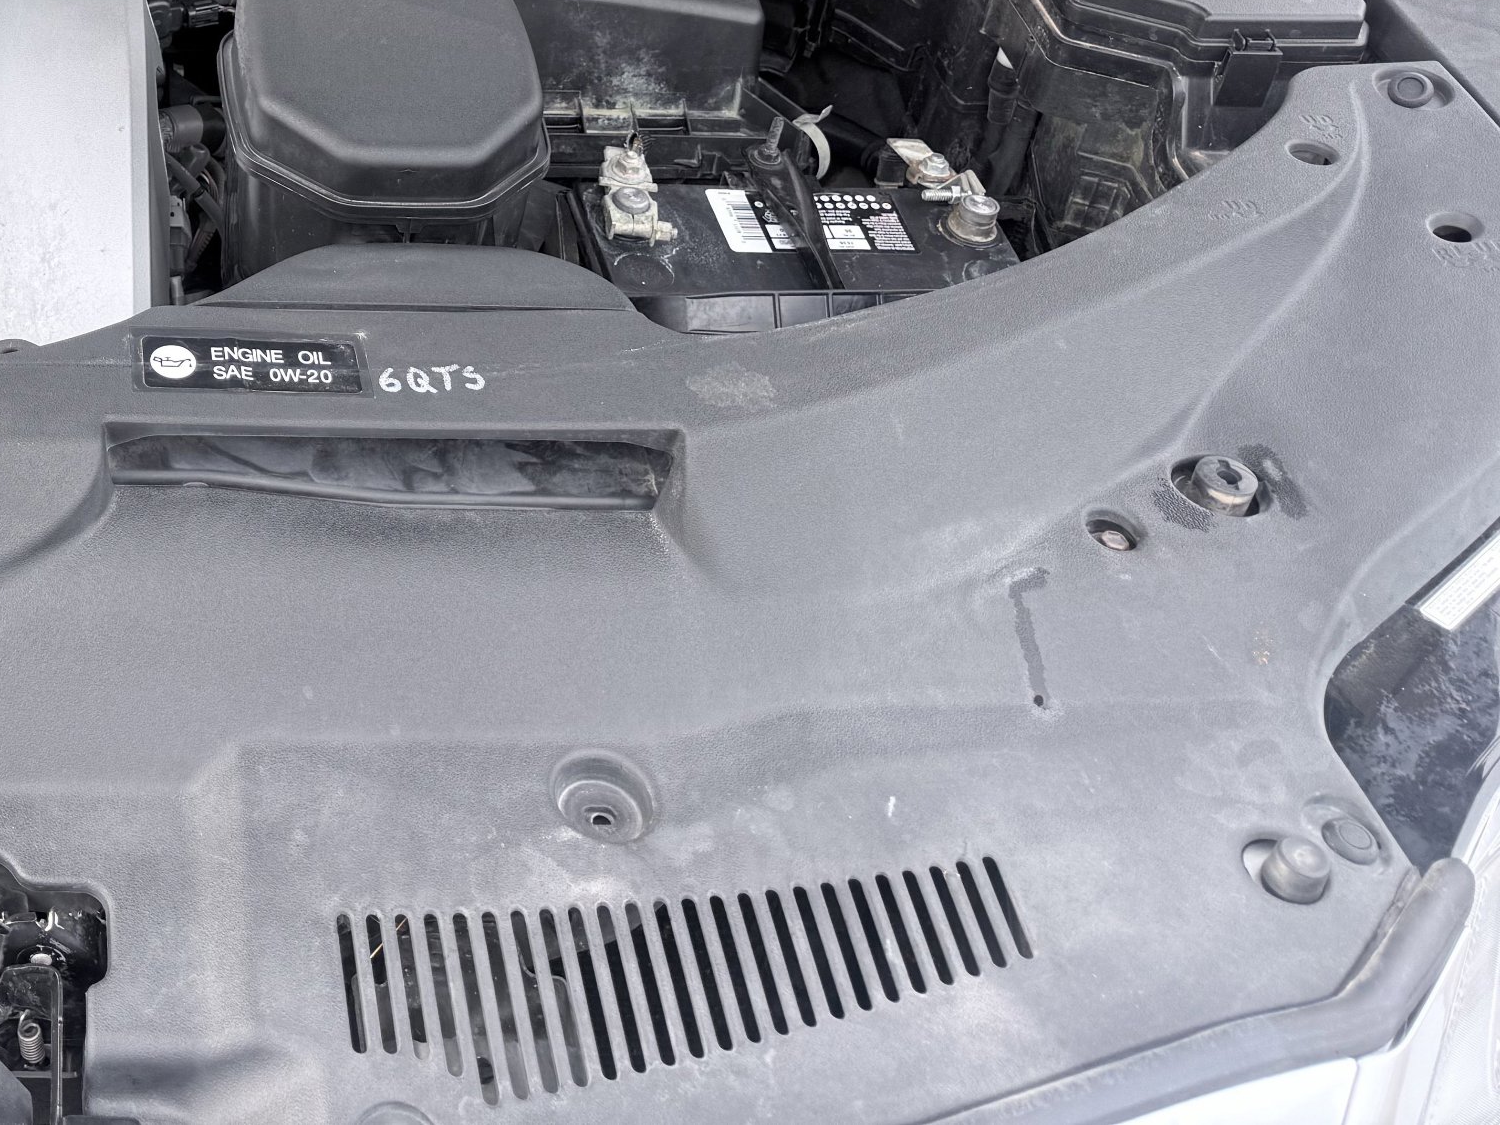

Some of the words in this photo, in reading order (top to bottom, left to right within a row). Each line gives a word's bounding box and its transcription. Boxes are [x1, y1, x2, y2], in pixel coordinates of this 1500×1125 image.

[210, 346, 284, 364] ENGINE
[298, 350, 332, 366] OIL
[212, 365, 254, 381] SAE
[268, 368, 333, 384] 0W-20
